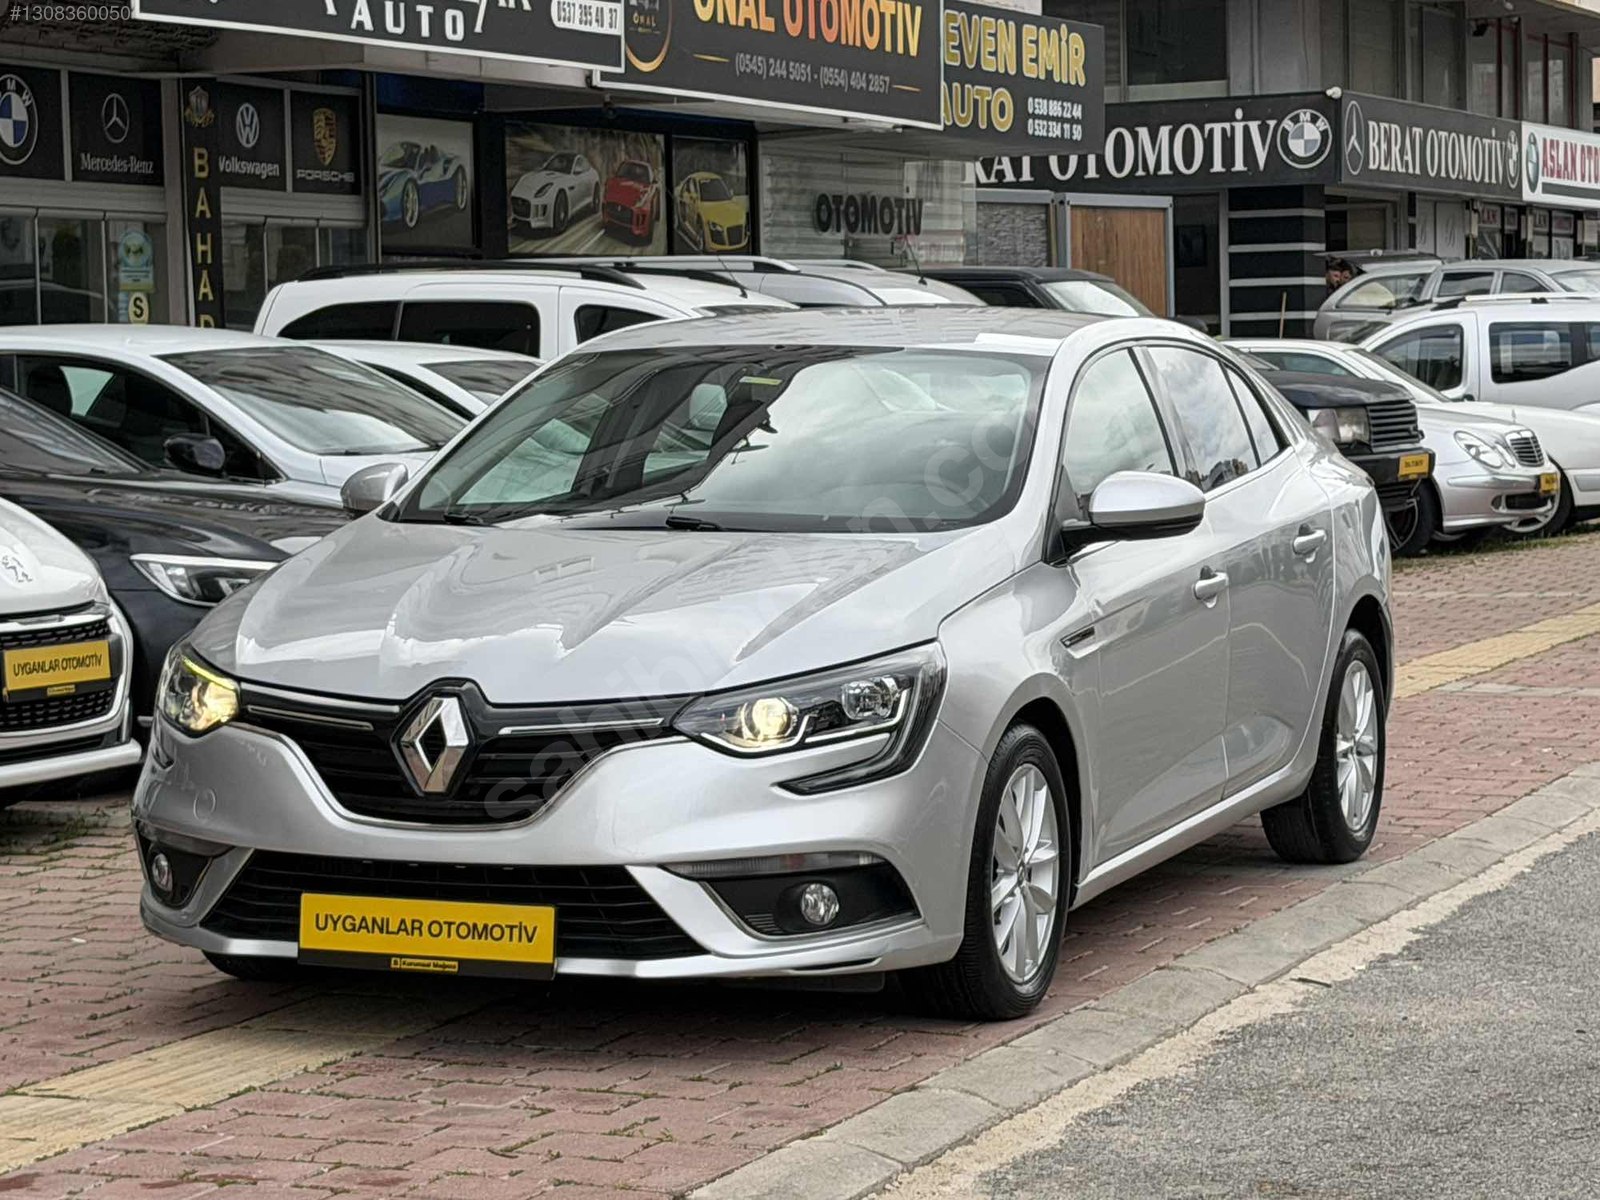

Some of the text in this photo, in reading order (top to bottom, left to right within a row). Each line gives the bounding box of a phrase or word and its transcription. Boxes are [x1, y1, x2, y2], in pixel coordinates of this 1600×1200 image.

[350, 0, 465, 42] AUTO
[735, 52, 767, 79] (0545)
[768, 58, 787, 78] 244
[788, 61, 812, 83] 5051
[819, 66, 849, 92] (0554)
[850, 71, 867, 91] 404
[868, 75, 890, 94] 2857
[1063, 101, 1072, 119] 22
[1072, 103, 1082, 120] 44
[79, 151, 155, 175] Mercedes-Benz
[1367, 120, 1424, 175] BERAT
[1426, 127, 1507, 186] OTOMOTİV
[1580, 144, 1600, 184] OTO
[218, 155, 280, 180] Volkswagen
[296, 168, 355, 183] PORSCHE
[133, 297, 145, 319] S
[13, 651, 103, 676] UYGANLAR OTOMOTİV
[314, 912, 538, 944] UYGANLAR OTOMOTİV
